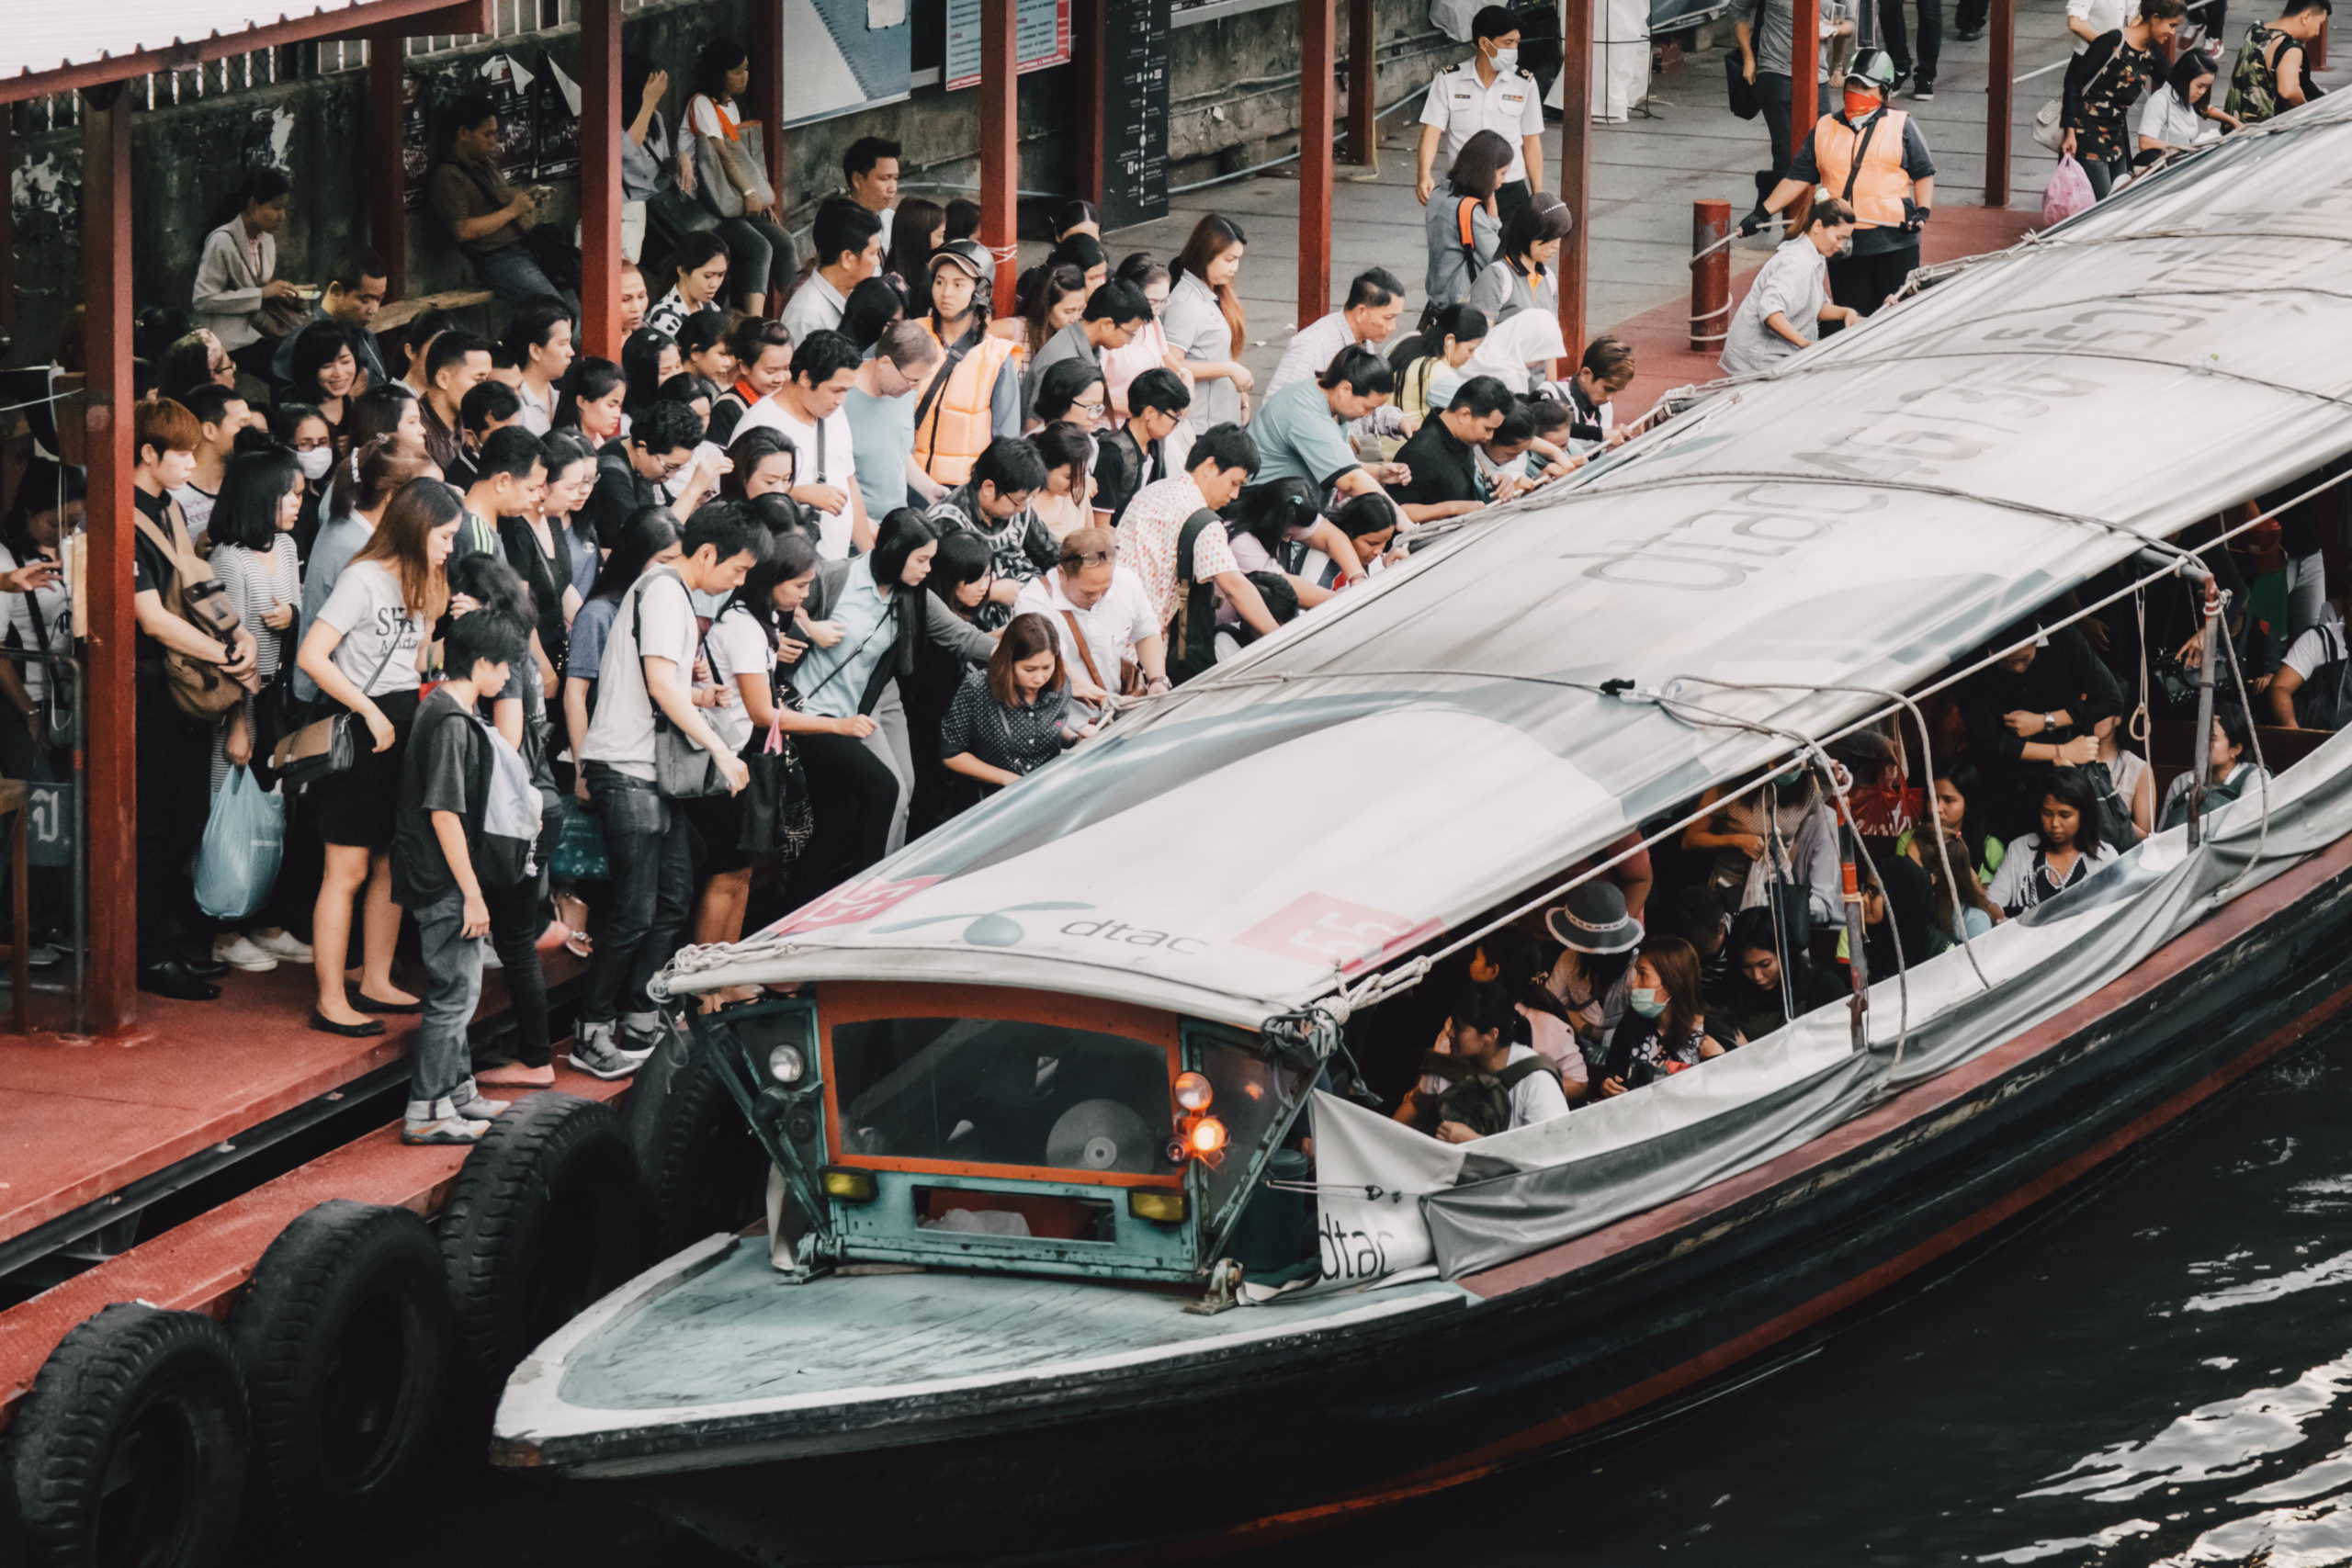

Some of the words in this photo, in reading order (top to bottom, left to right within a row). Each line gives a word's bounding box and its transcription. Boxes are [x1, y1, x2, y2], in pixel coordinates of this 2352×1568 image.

[1558, 482, 1890, 591] dtac
[1059, 919, 1211, 955] dtac
[1286, 910, 1400, 955] 55
